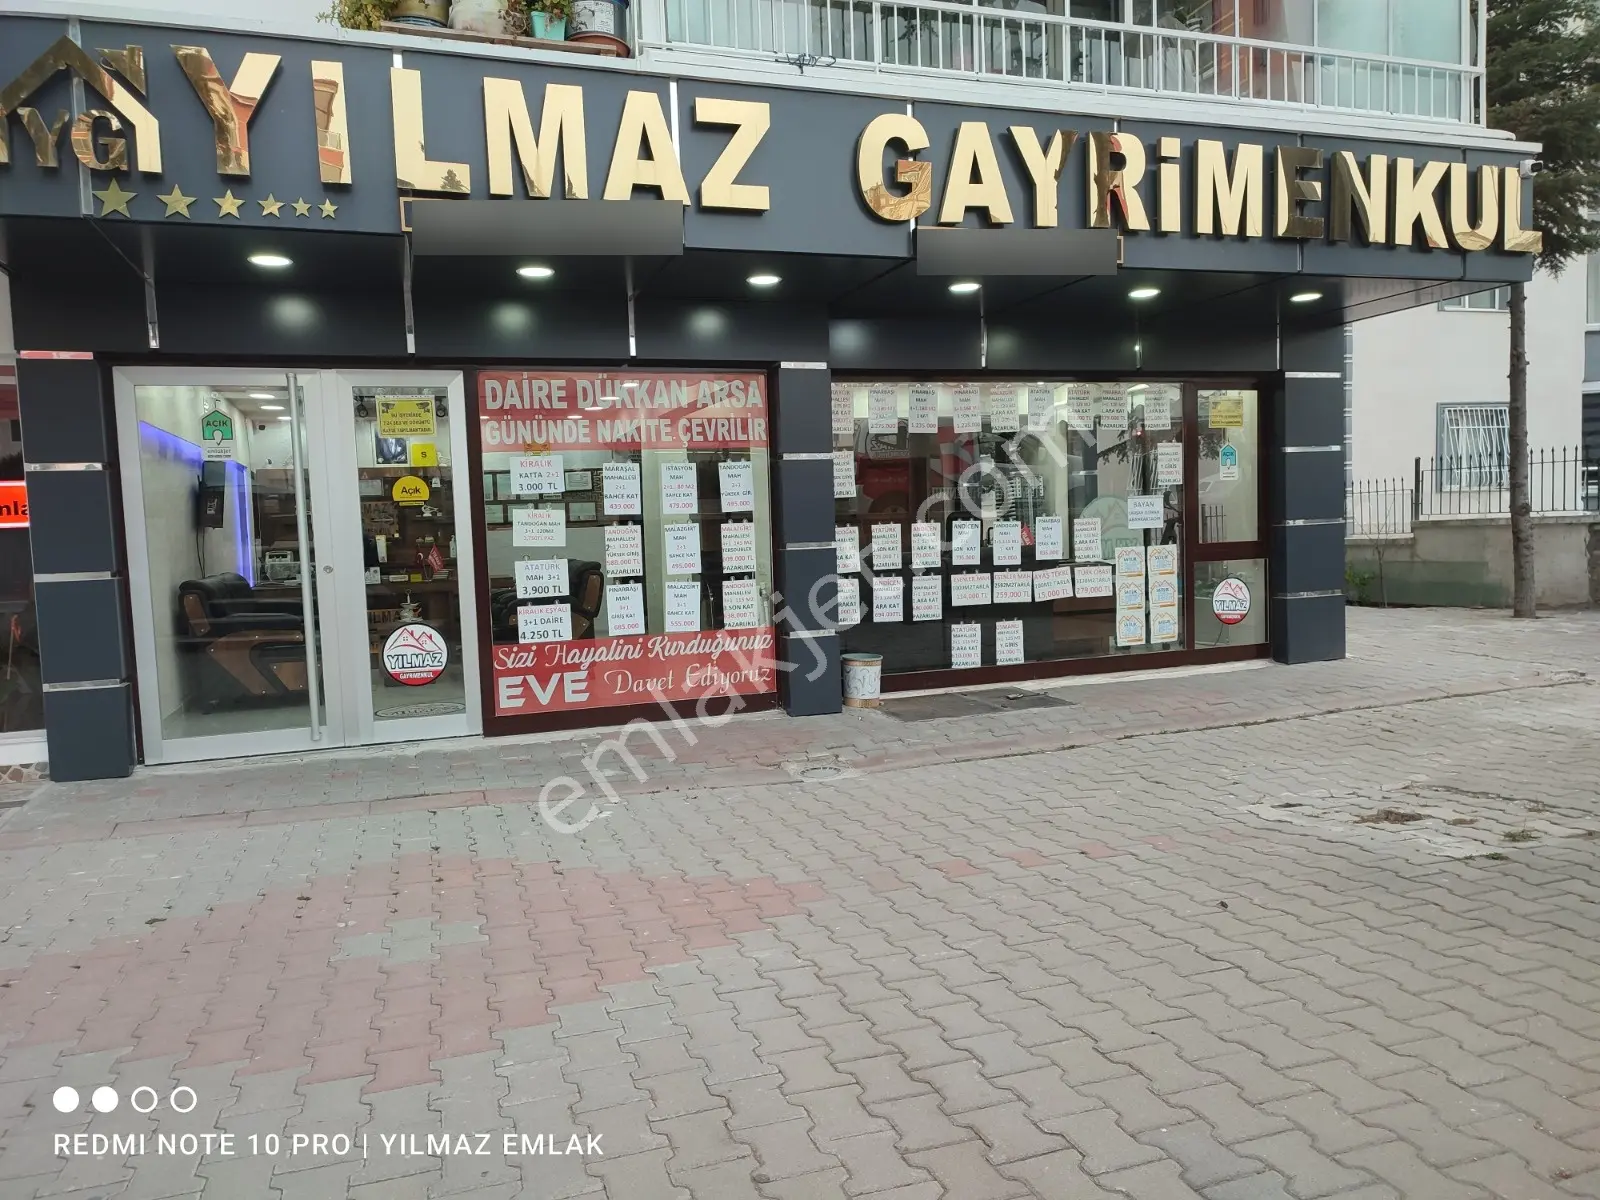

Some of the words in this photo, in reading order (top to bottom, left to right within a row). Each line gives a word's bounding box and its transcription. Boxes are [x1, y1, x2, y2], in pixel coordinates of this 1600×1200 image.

[169, 43, 771, 211] YILMAZ
[485, 372, 568, 409] DAİRE
[577, 373, 688, 409] DÜKKAN
[696, 380, 763, 408] ARSA
[485, 415, 590, 445] GÜNÜNDE
[678, 413, 767, 448] ÇEVRİLİR
[520, 459, 552, 468] KİRALIK
[400, 486, 421, 496] Açık
[518, 483, 543, 491] 3.000
[548, 482, 558, 490] TL
[522, 585, 550, 596] 3,900
[552, 585, 563, 594] TL
[1038, 590, 1060, 599] 15,000
[1214, 599, 1248, 611] YILMAZ
[540, 616, 564, 625] DAİRE
[520, 630, 549, 640] 4.250
[552, 629, 563, 638] TL
[494, 645, 538, 670] Sizi
[544, 636, 643, 670] Hayalini
[647, 633, 774, 658] Kurduğunuz
[387, 652, 443, 669] YILMAZ
[498, 670, 591, 709] EVE
[603, 663, 675, 696] Davet
